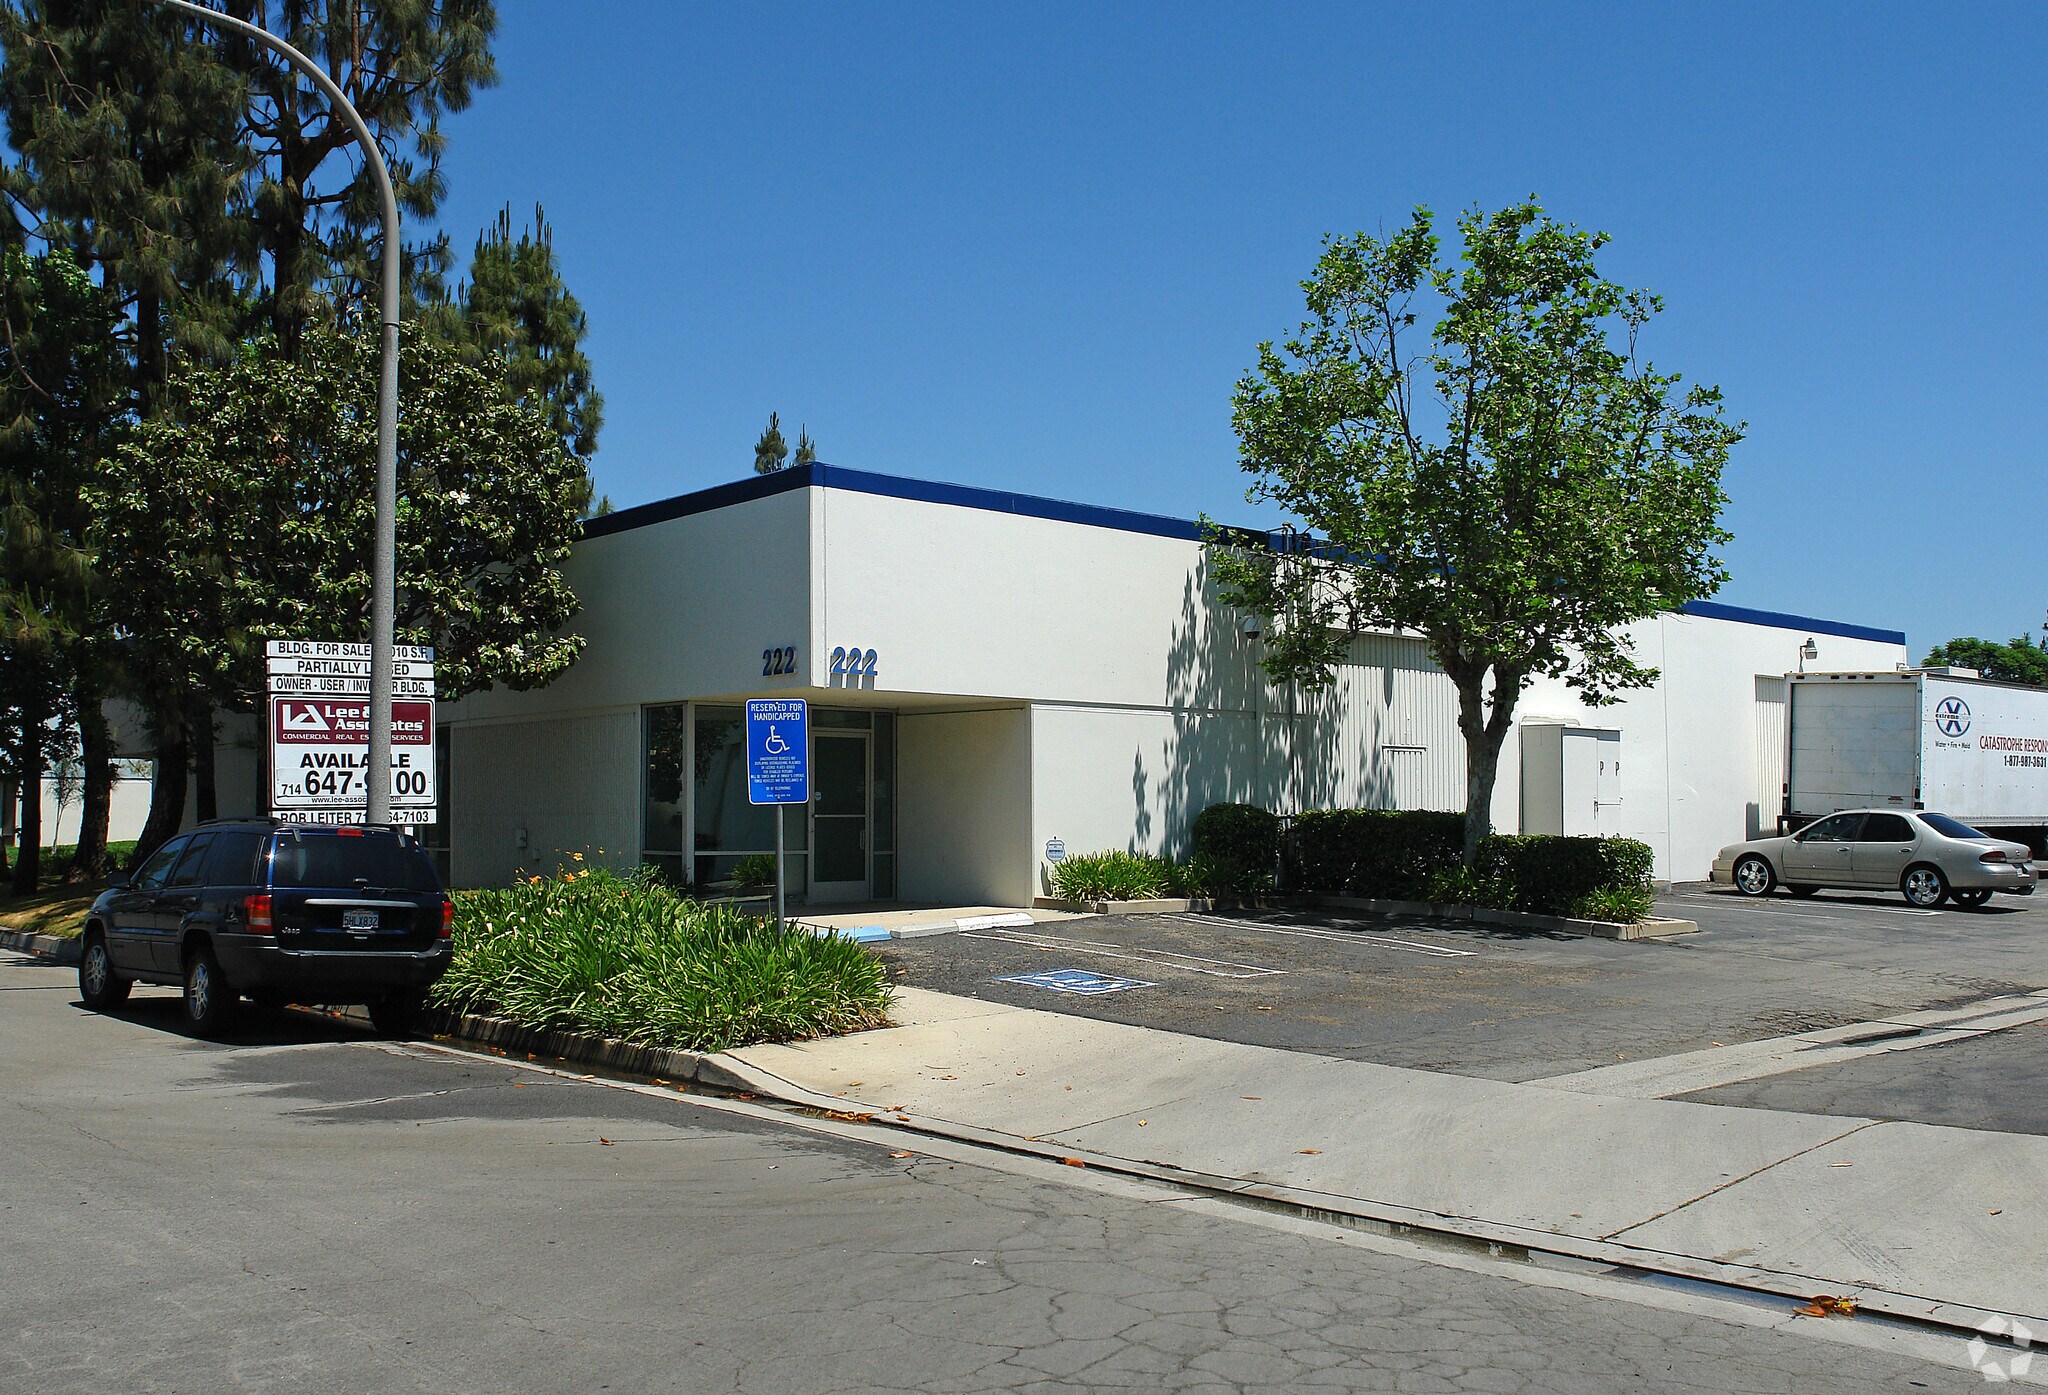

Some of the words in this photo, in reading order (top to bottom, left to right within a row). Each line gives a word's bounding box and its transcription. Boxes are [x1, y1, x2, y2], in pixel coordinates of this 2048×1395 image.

[278, 642, 313, 655] BLDG.
[316, 643, 339, 656] FOR
[343, 644, 371, 657] SALE
[762, 646, 795, 676] 222
[832, 646, 878, 675] 222
[297, 661, 361, 675] PARTIALLY
[276, 678, 312, 691] OWNER
[320, 679, 345, 691] USER
[400, 681, 428, 693] BLDG.
[325, 705, 360, 718] Lee
[751, 703, 787, 712] RESERVED
[789, 703, 803, 712] FOR
[753, 712, 801, 721] HANDICAPPED
[335, 718, 423, 732] Assates
[1979, 735, 2023, 751] CATASTROPHE
[300, 753, 411, 768] AVAILALE
[281, 784, 301, 795] 714
[305, 770, 426, 795] 647-00
[310, 812, 352, 824] LEITER
[282, 926, 300, 935] Jeep
